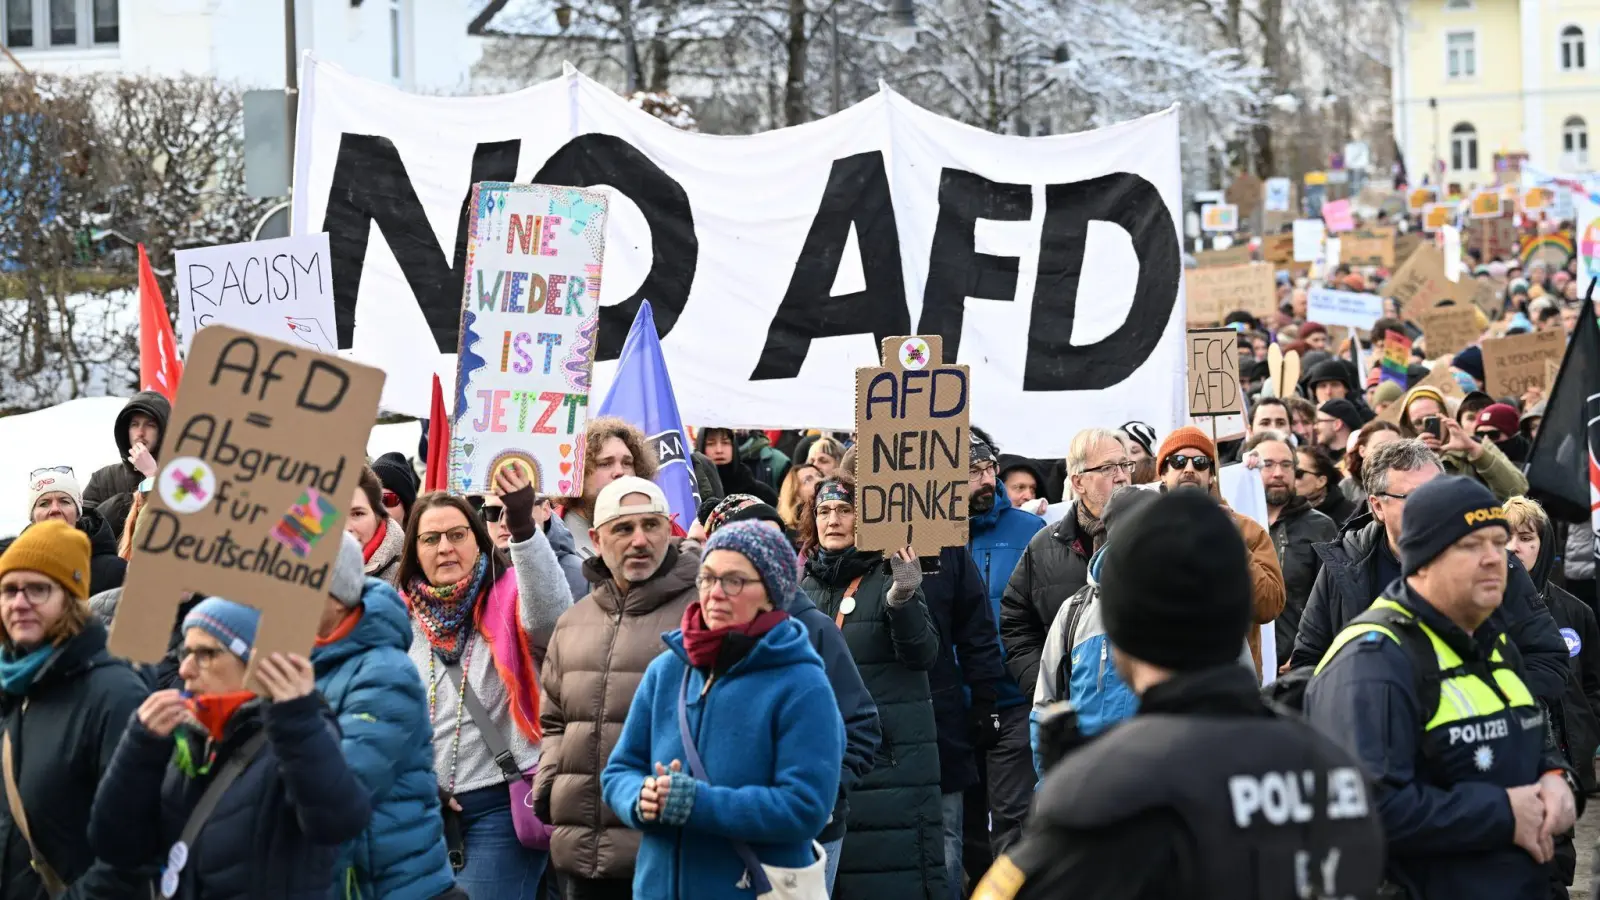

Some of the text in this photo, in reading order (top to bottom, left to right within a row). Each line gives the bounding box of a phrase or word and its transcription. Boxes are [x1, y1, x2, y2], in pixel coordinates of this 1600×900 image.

[506, 213, 562, 257] NIE
[188, 252, 323, 311] RACISM
[323, 132, 1180, 391] NO AFD
[477, 269, 587, 318] WIEDER
[210, 336, 350, 412] AfD
[500, 330, 562, 375] IST
[1193, 338, 1235, 370] FCK
[473, 389, 588, 435] JETZT
[866, 369, 967, 420] AFD
[1192, 371, 1237, 413] AFD
[174, 413, 346, 496] Abgrund
[872, 427, 960, 473] NEIN
[214, 481, 267, 525] für
[862, 480, 968, 524] DANKE
[138, 508, 330, 591] Deutschland
[1448, 718, 1508, 746] POLIZEI
